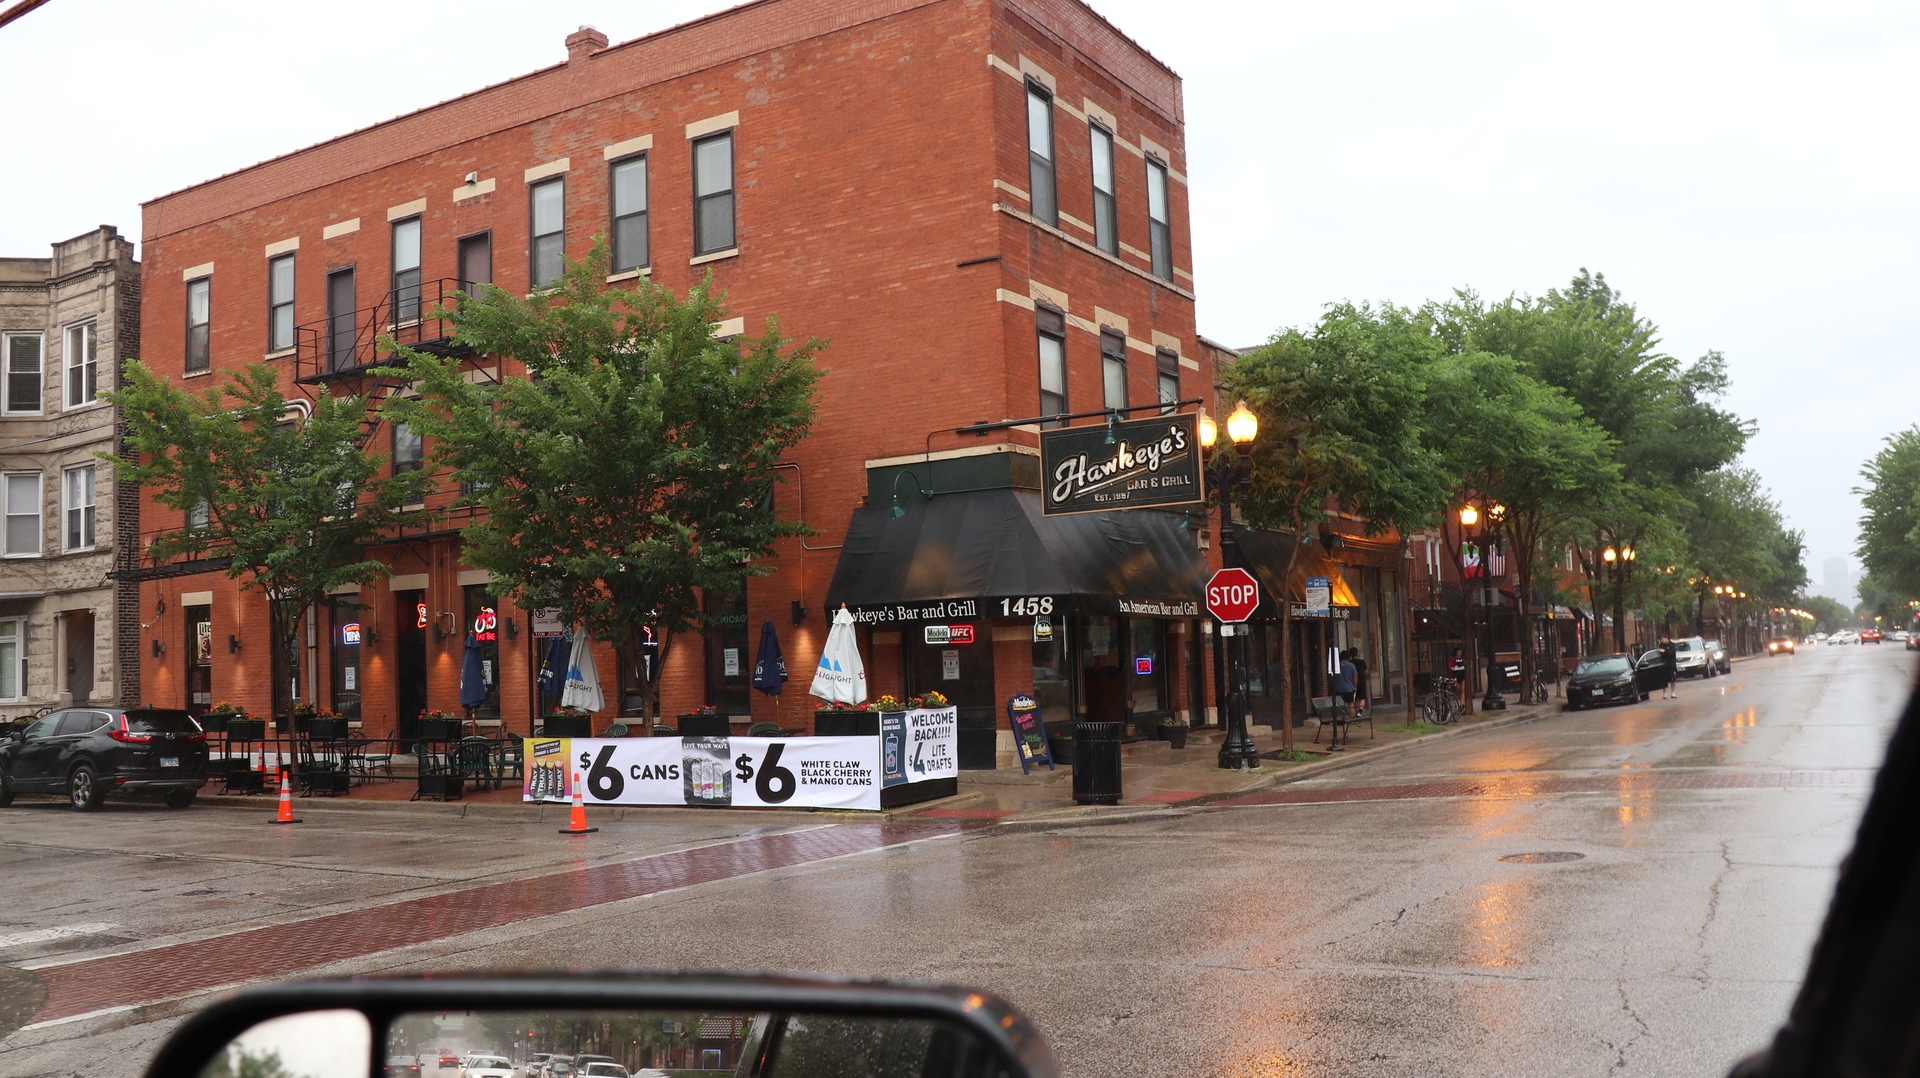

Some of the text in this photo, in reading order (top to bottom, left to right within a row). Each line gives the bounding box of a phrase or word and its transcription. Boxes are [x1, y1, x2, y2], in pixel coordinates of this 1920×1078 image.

[1052, 426, 1185, 502] Hawkeye's
[1127, 474, 1191, 490] BAR & GRILL
[1094, 493, 1112, 502] EST.
[1209, 584, 1254, 607] STOP
[832, 600, 976, 625] Hwkeye's Bar and Grill
[1000, 597, 1053, 616] 1458
[1119, 599, 1198, 616] An American Bar and Grill
[927, 627, 969, 637] Modelo UFC
[1014, 697, 1033, 708] Modelo
[911, 711, 954, 728] WELCOME
[914, 726, 951, 742] BACK!!!!
[909, 741, 926, 776] $4
[932, 744, 946, 757] LITE
[579, 745, 680, 800] $6 CANS
[801, 760, 860, 769] WHITE CLAW
[926, 757, 952, 772] DRAFTS
[530, 770, 538, 790] TRULY
[735, 743, 797, 804] $6
[801, 769, 872, 777] BLACK CHERRY
[801, 777, 872, 786] & MANGO CANS
